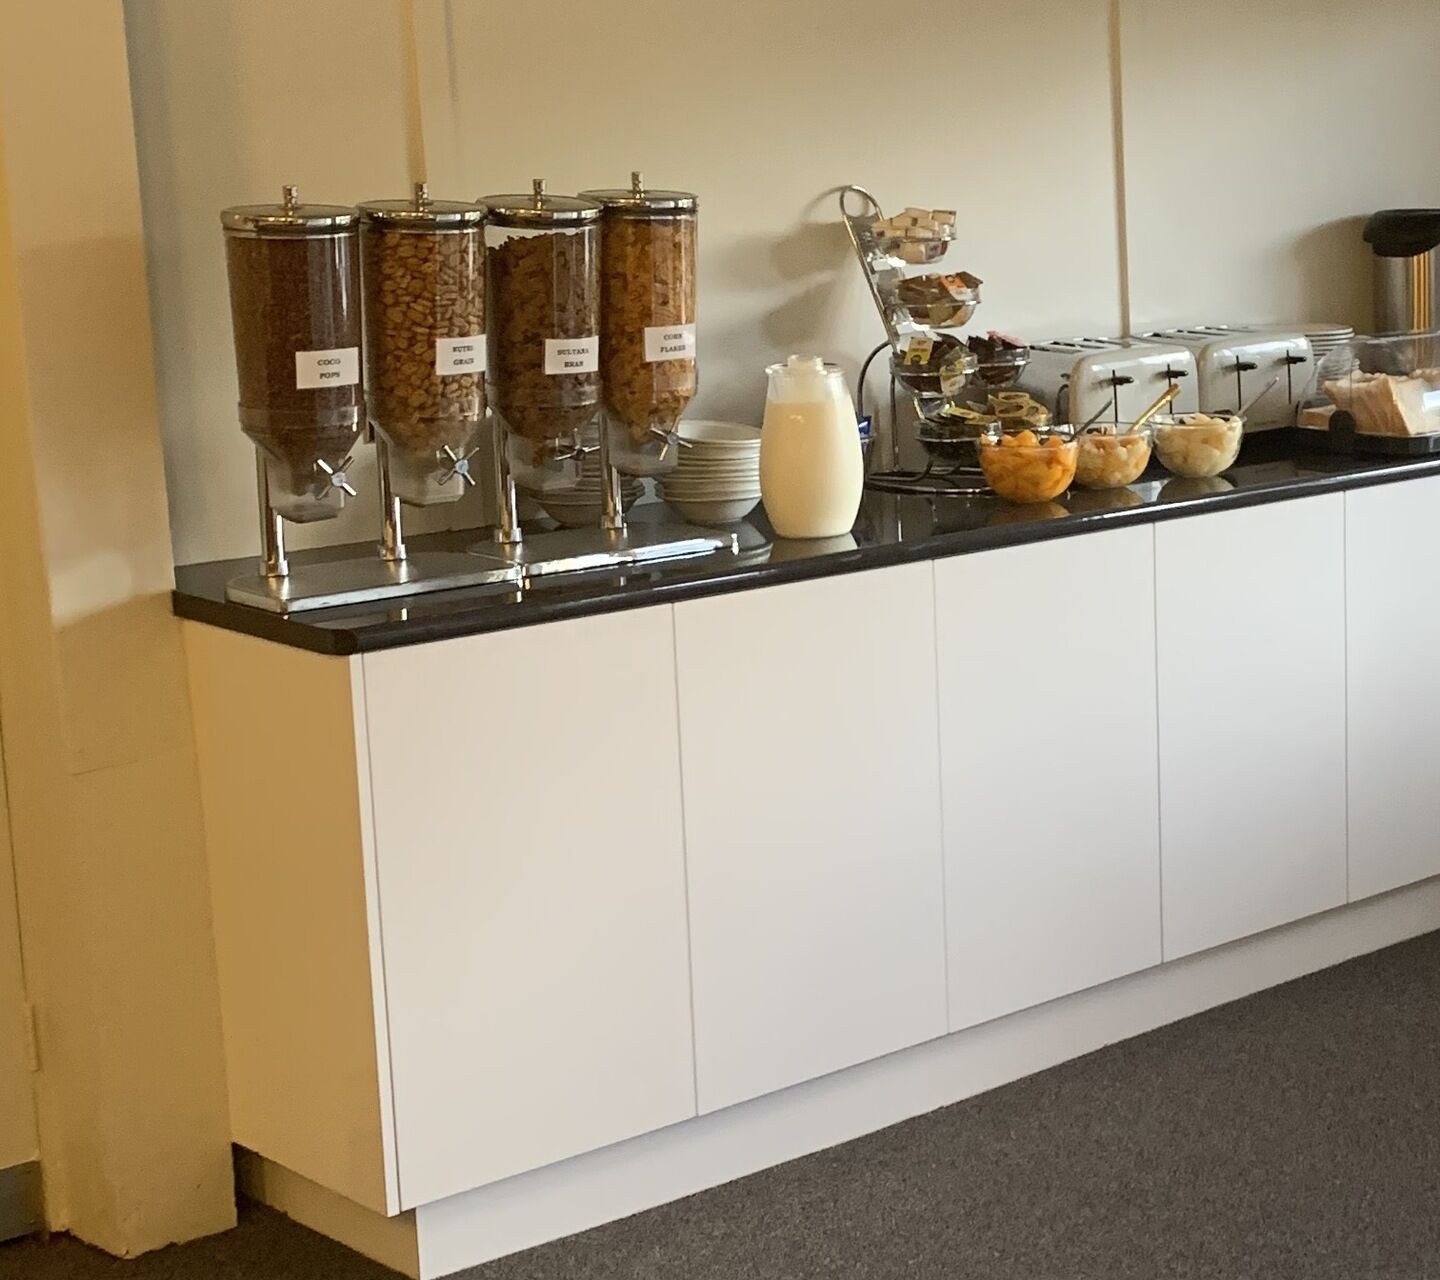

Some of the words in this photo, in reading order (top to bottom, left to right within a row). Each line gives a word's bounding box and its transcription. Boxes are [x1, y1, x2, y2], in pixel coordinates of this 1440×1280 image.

[663, 333, 683, 341] CORN
[557, 347, 590, 356] SULTANA
[660, 344, 687, 353] FLAKES
[317, 358, 341, 366] COCO
[319, 372, 340, 380] POPS
